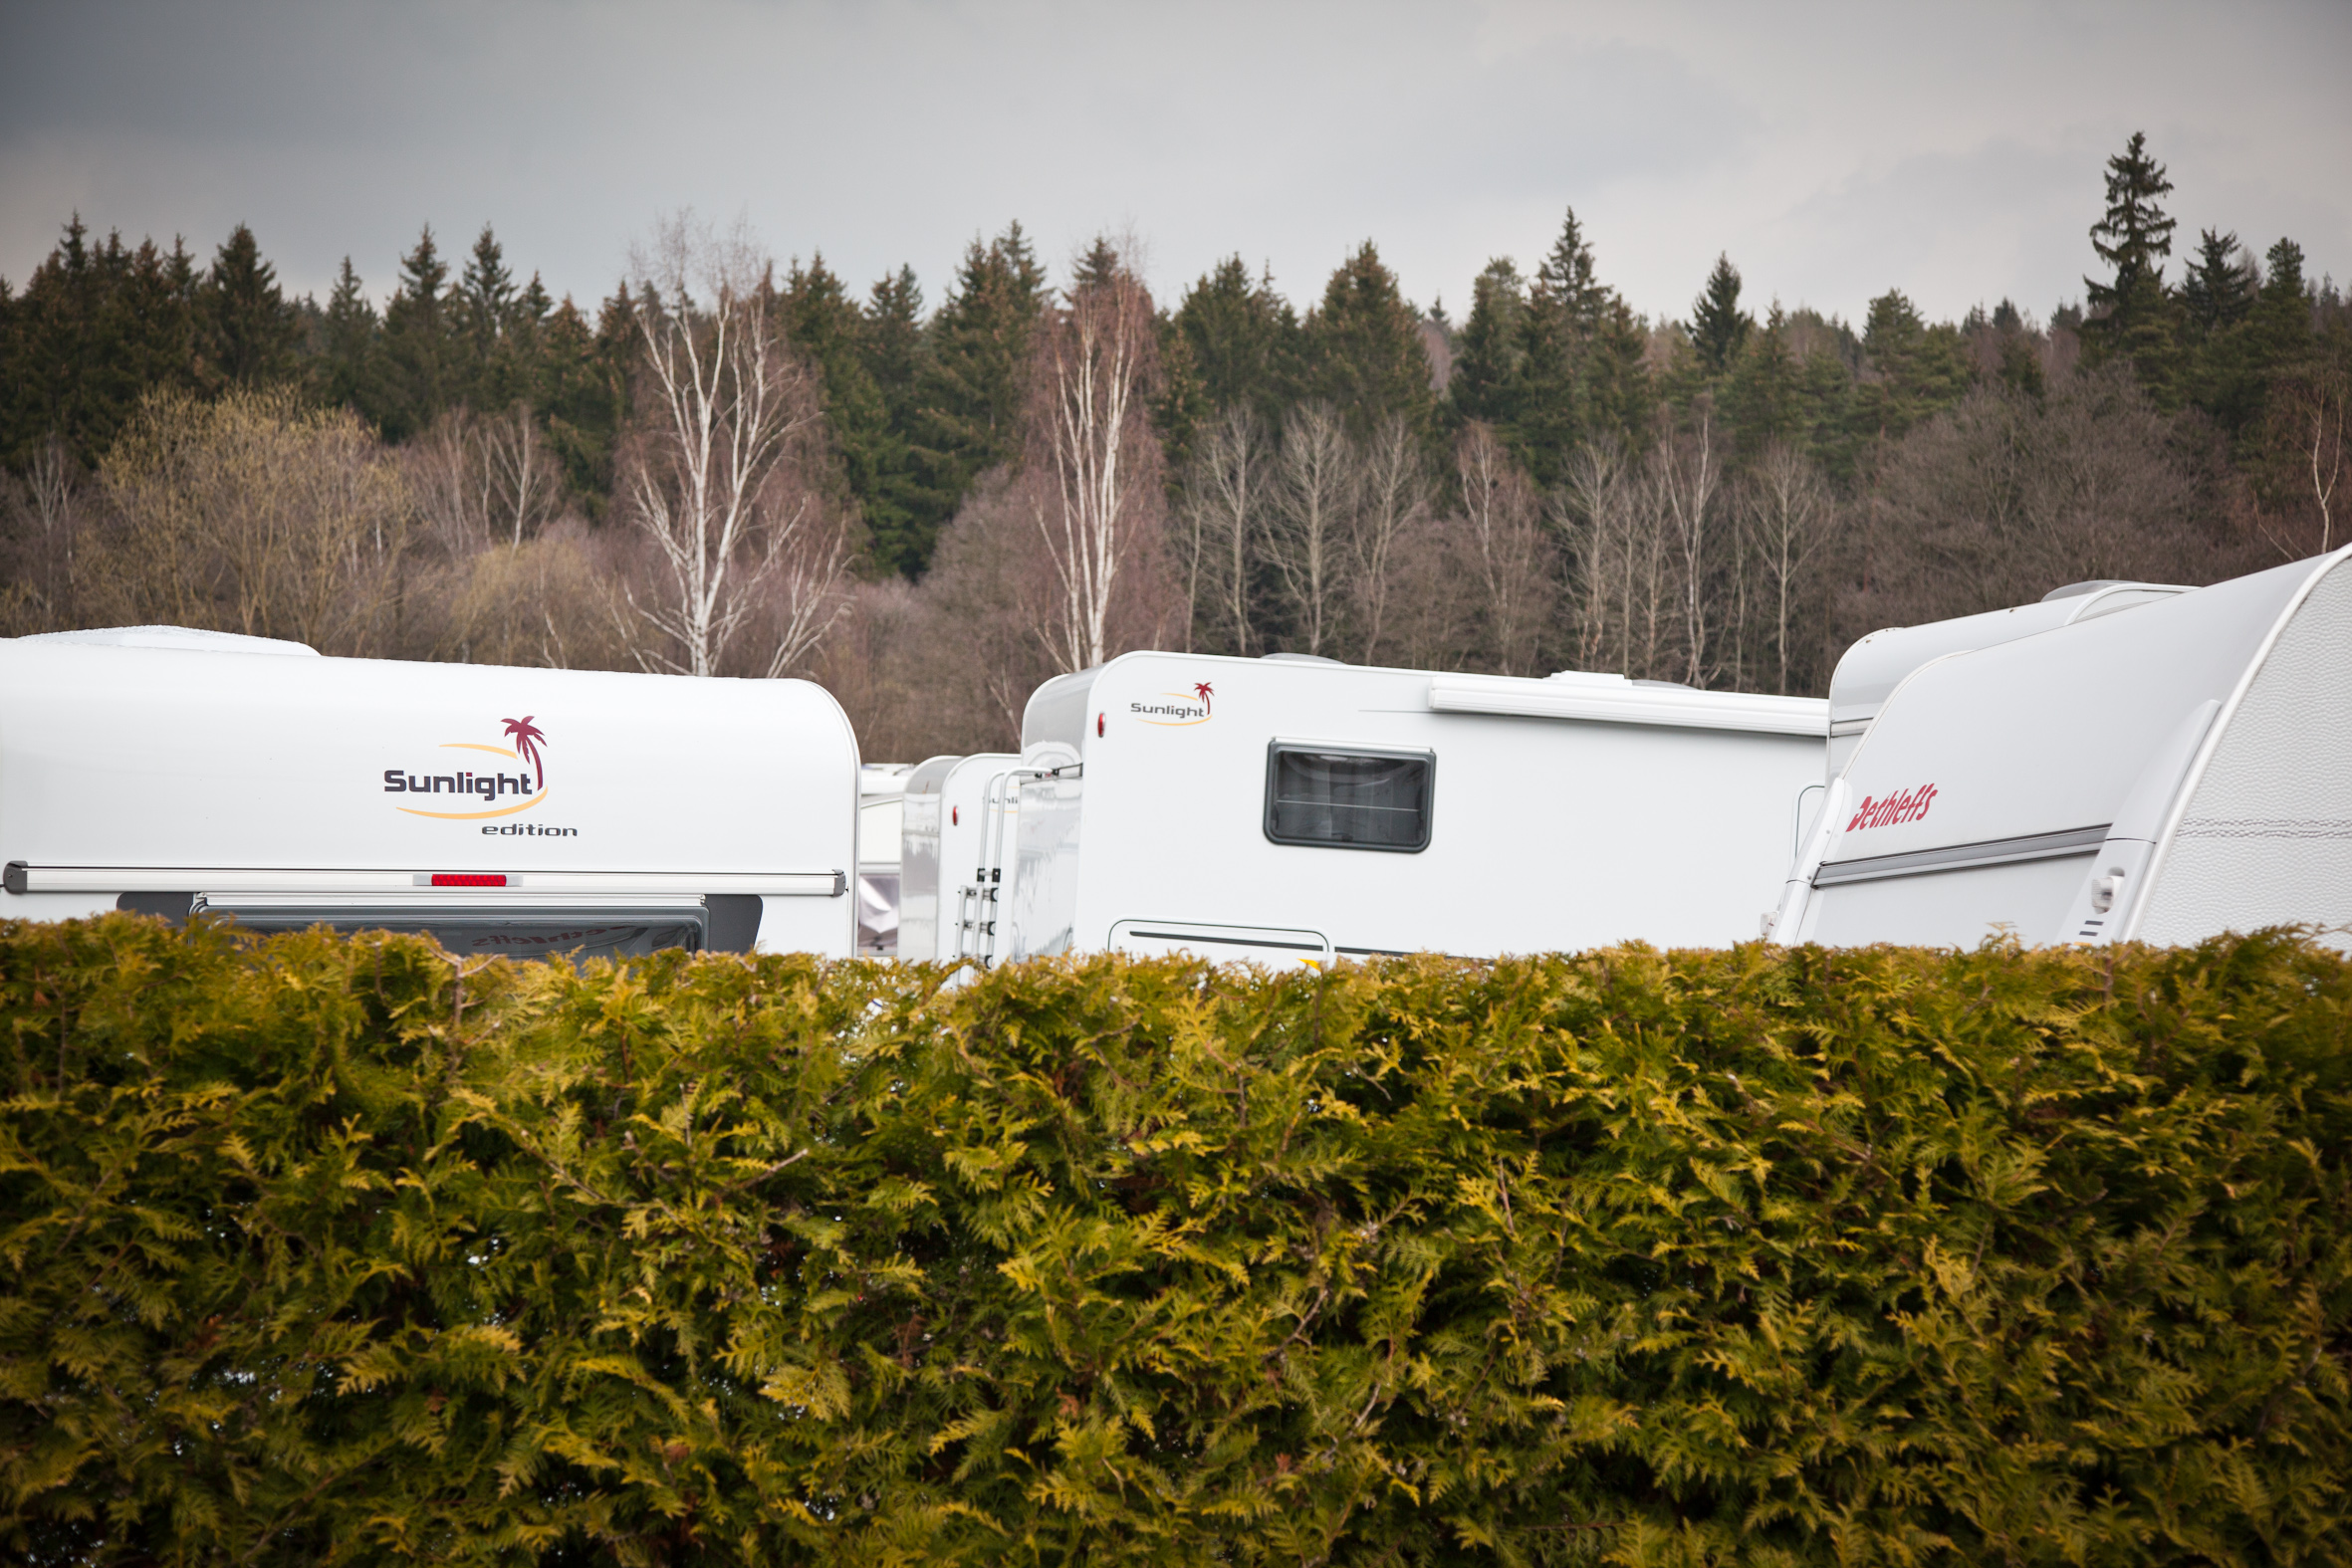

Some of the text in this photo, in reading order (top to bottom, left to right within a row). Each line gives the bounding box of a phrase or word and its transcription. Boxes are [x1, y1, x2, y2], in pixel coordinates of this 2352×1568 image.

[1130, 703, 1205, 719] Sunlight
[383, 770, 533, 801] Sunlight
[1845, 783, 1939, 832] Dethleffs
[481, 823, 579, 837] edition
